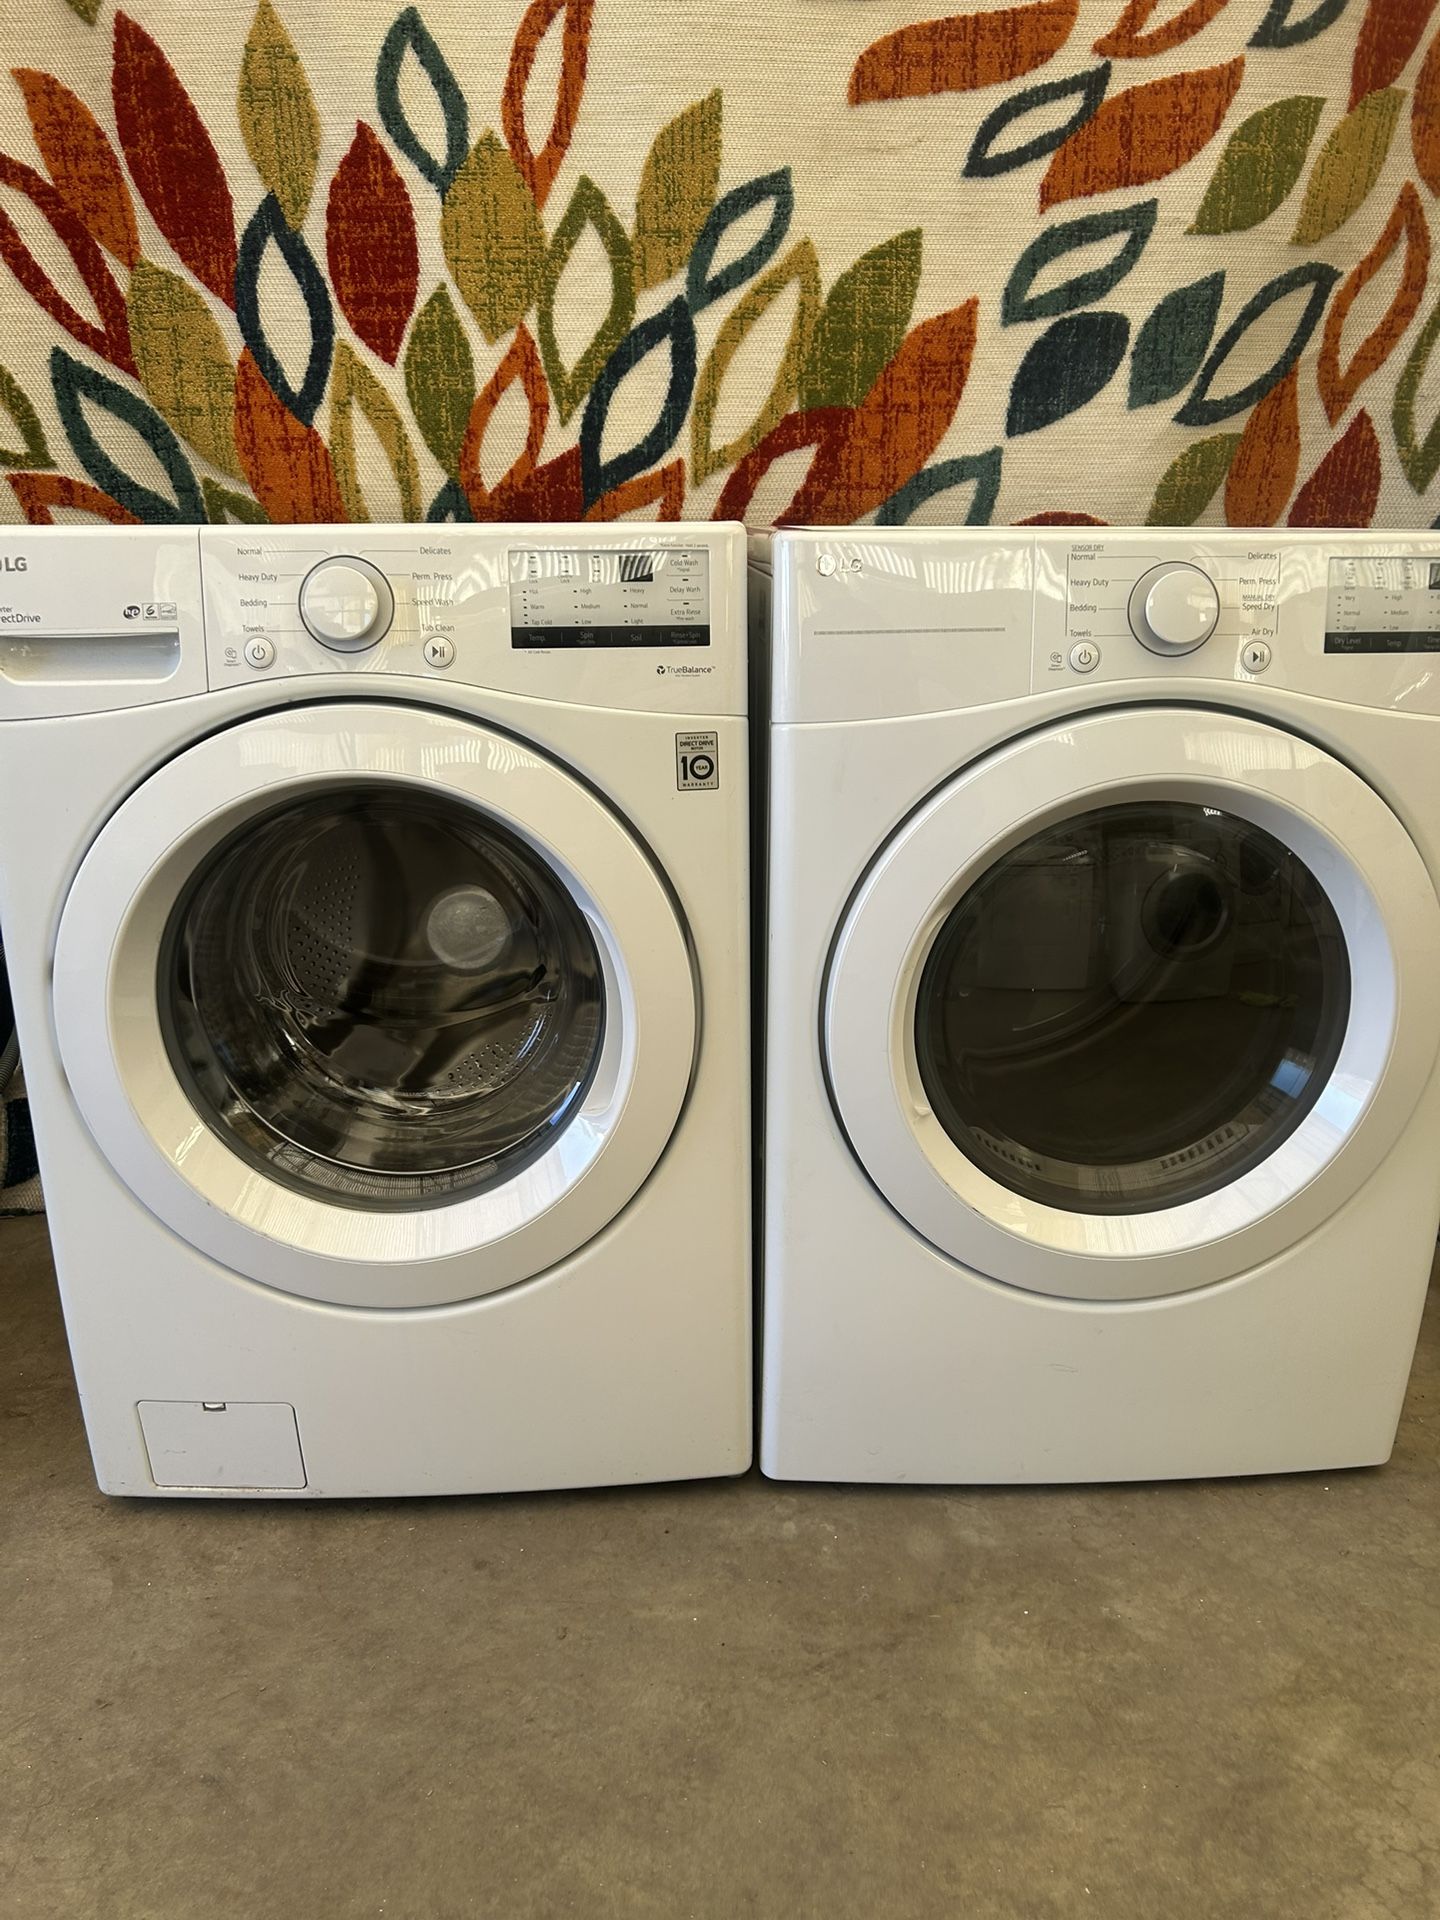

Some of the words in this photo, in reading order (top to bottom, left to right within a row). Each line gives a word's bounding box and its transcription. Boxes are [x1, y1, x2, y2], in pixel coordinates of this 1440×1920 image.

[237, 547, 262, 555] Normal
[420, 546, 452, 555] Delicates
[1248, 552, 1277, 560] Delicates
[4, 557, 27, 571] LG
[839, 558, 863, 573] LG
[238, 573, 259, 582] Heavy
[261, 573, 278, 582] Duty
[412, 572, 431, 581] Perm.
[434, 572, 452, 581] Press
[1070, 578, 1091, 587] Heavy
[1092, 578, 1109, 587] Duty
[670, 586, 684, 594] Delay
[240, 599, 268, 608] Bedding
[412, 598, 434, 607] Speed
[1242, 603, 1262, 611] Speed
[1263, 603, 1275, 611] Dry
[1070, 604, 1097, 613] Bedding
[0, 614, 41, 623] ectDrive
[242, 624, 264, 632] Towels
[435, 624, 455, 632] Clean
[1252, 628, 1261, 636] Air
[1262, 628, 1274, 637] Dry
[580, 632, 594, 640] Spin
[1070, 629, 1092, 637] Towels
[631, 634, 642, 642] Soil
[681, 755, 714, 780] 10
